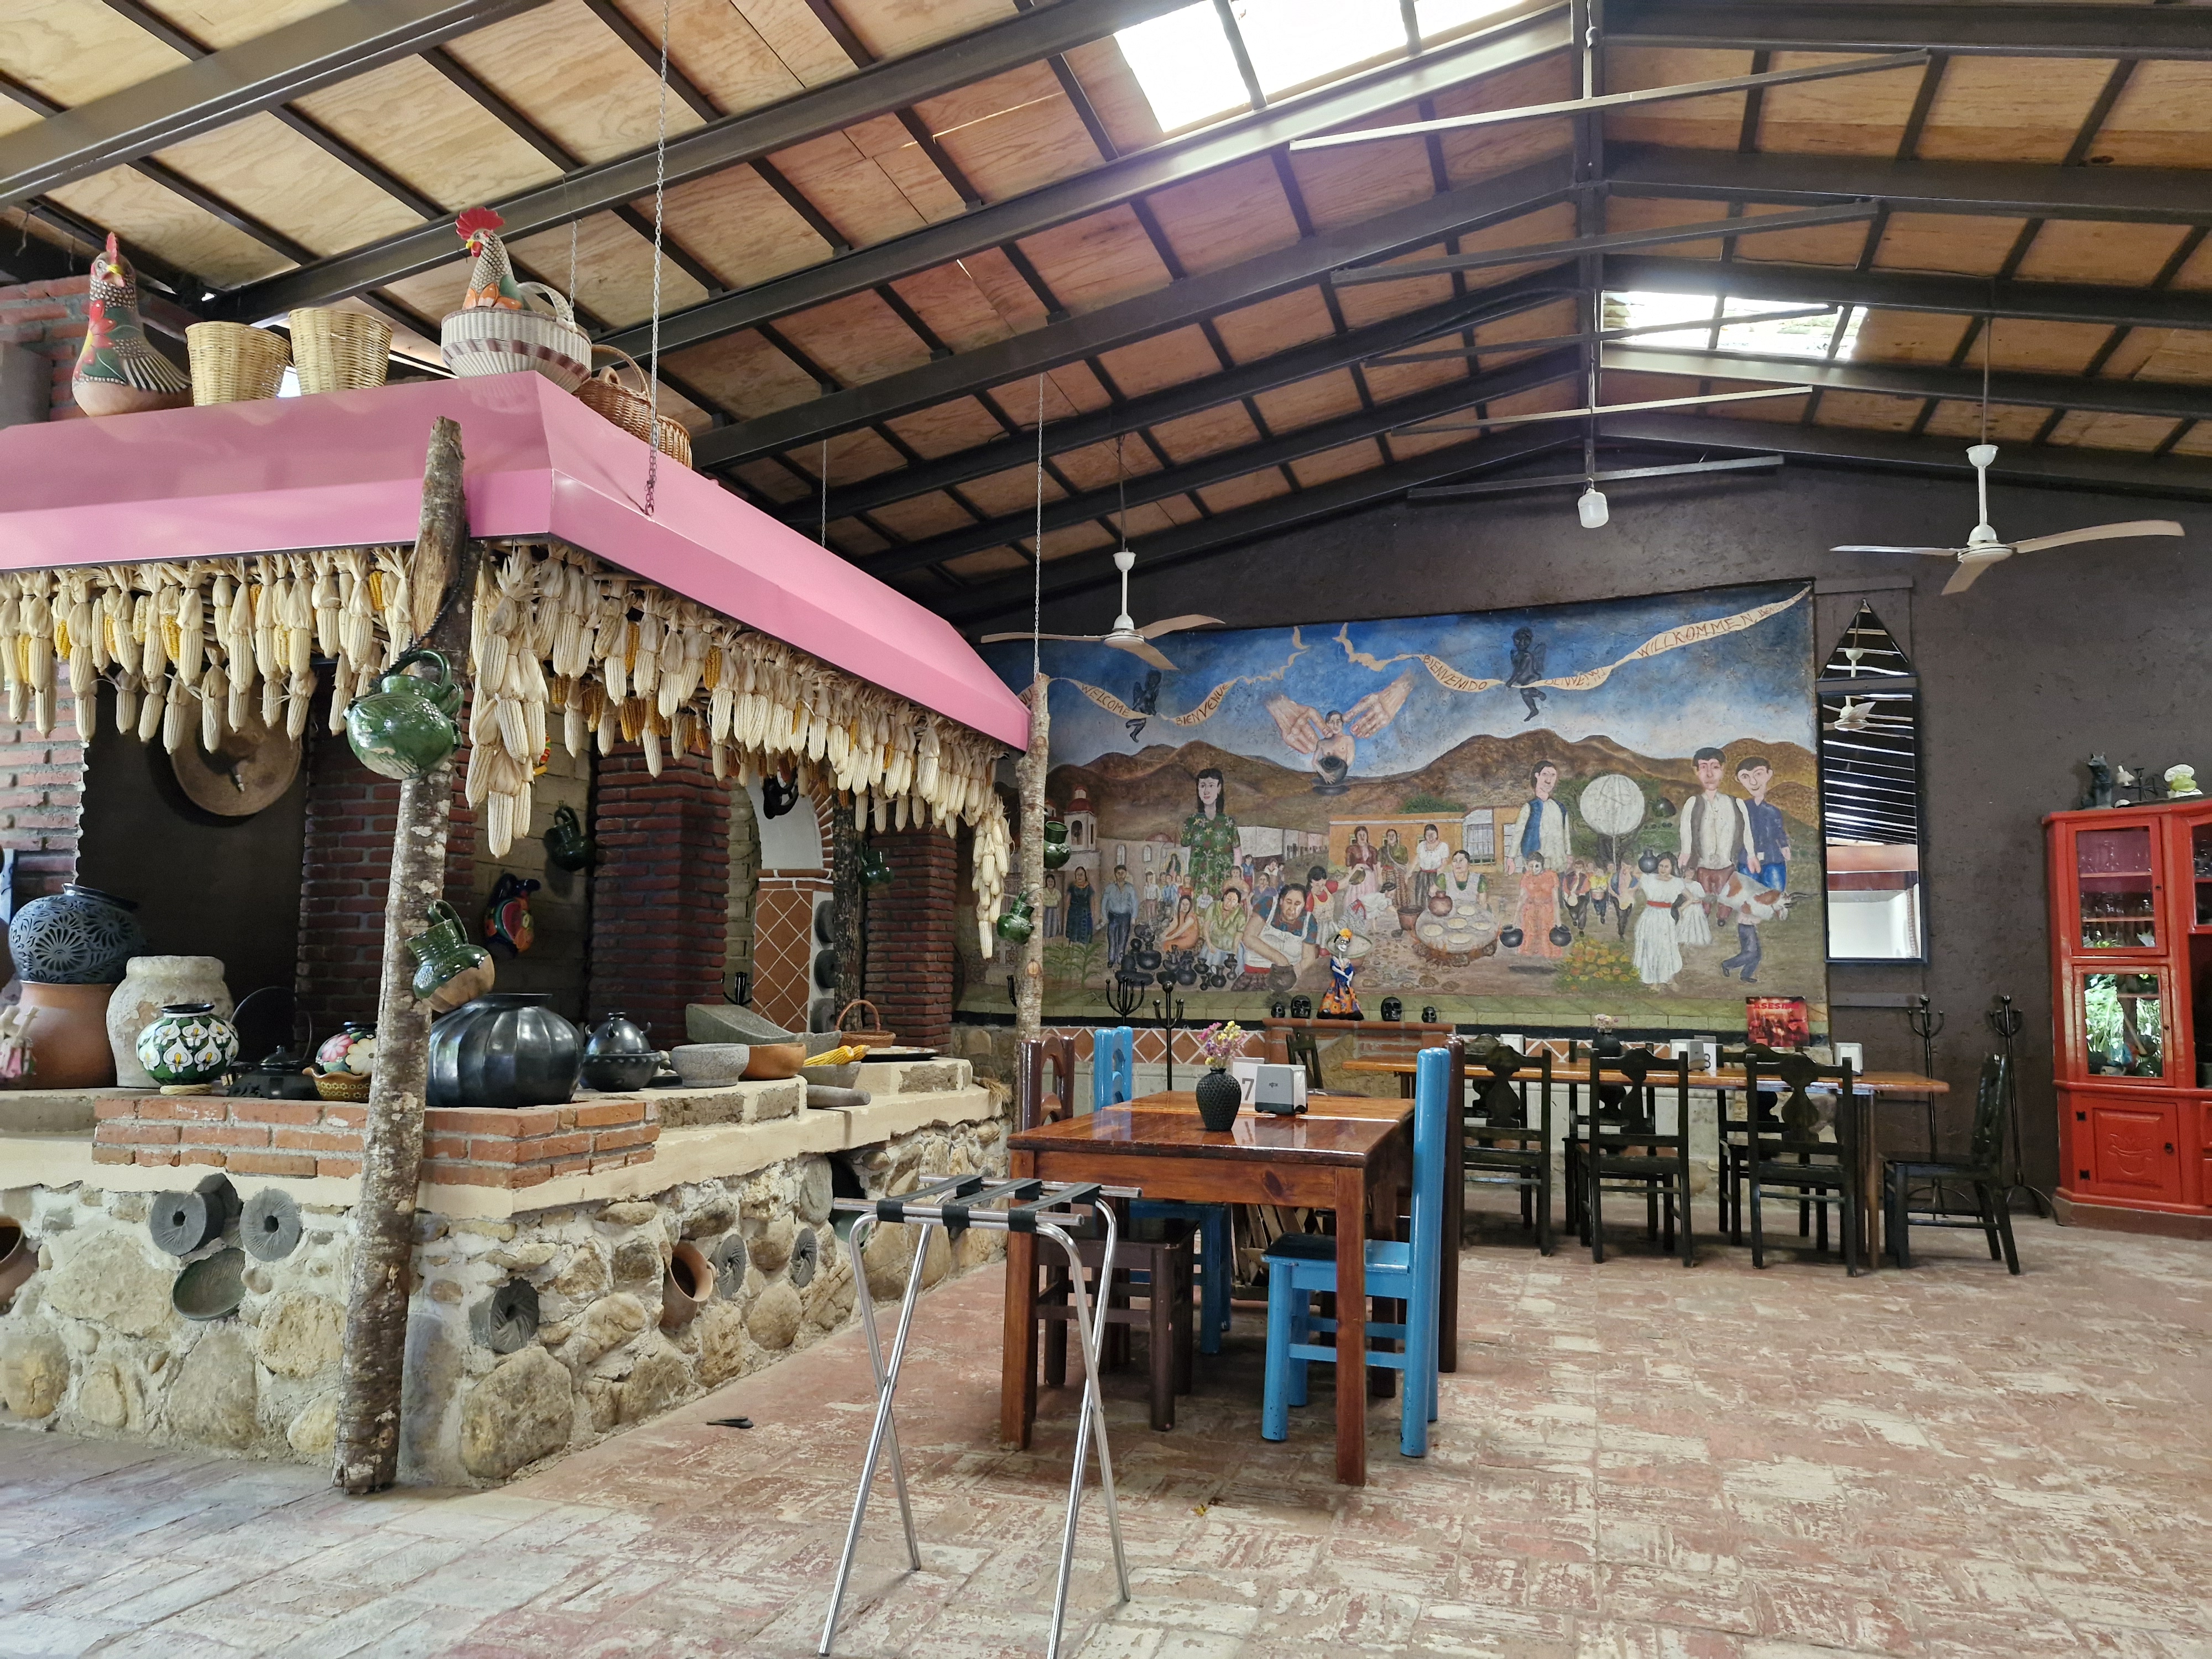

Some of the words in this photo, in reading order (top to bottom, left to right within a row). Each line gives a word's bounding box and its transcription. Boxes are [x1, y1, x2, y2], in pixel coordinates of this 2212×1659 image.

[1423, 649, 1488, 691] BIENVENIDO
[1082, 684, 1130, 717] WELCOME
[1176, 684, 1229, 726] BIENVENUE
[1241, 1077, 1254, 1101] 7
